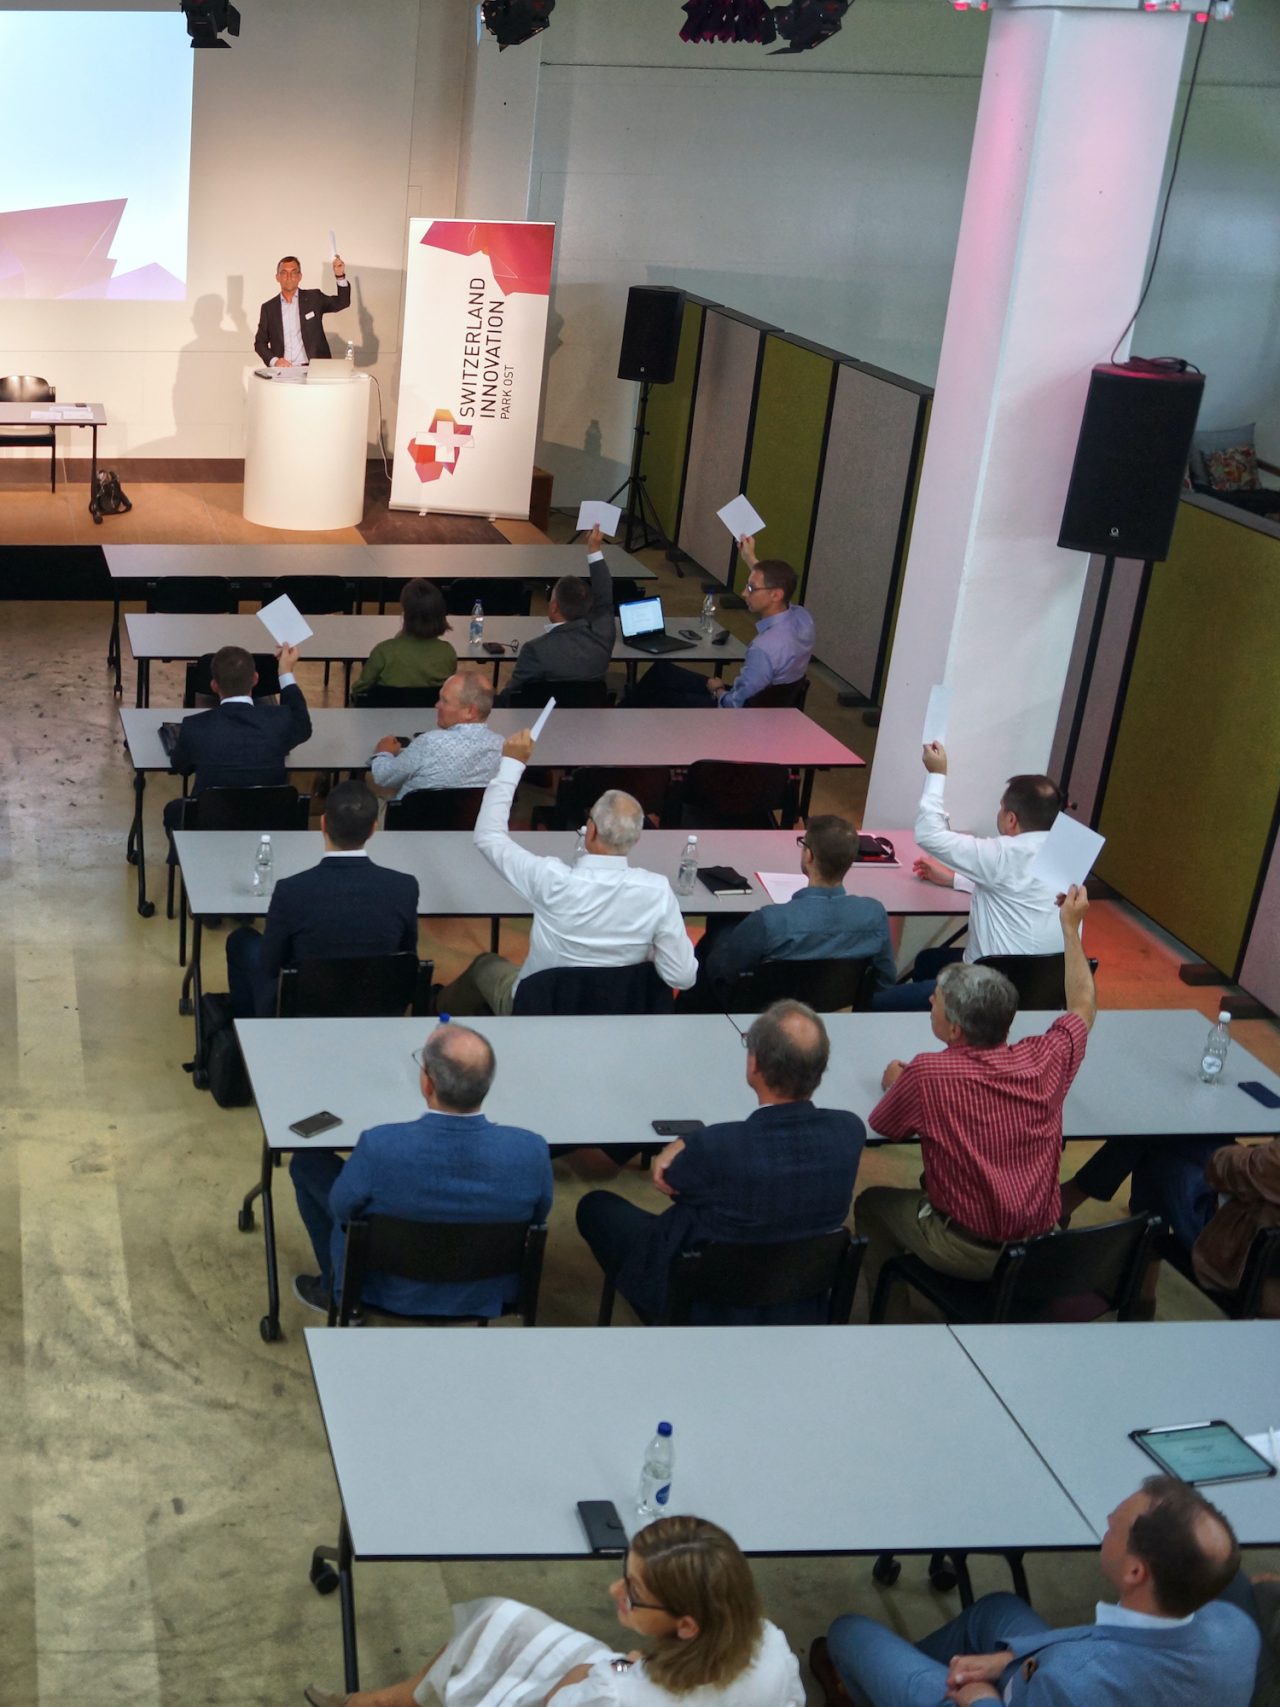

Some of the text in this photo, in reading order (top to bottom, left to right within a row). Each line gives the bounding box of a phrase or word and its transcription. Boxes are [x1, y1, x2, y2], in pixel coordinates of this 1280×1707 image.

[459, 277, 486, 418] SWITZERLAND
[480, 300, 505, 418] INNOVATION
[500, 365, 515, 420] PARK OST
